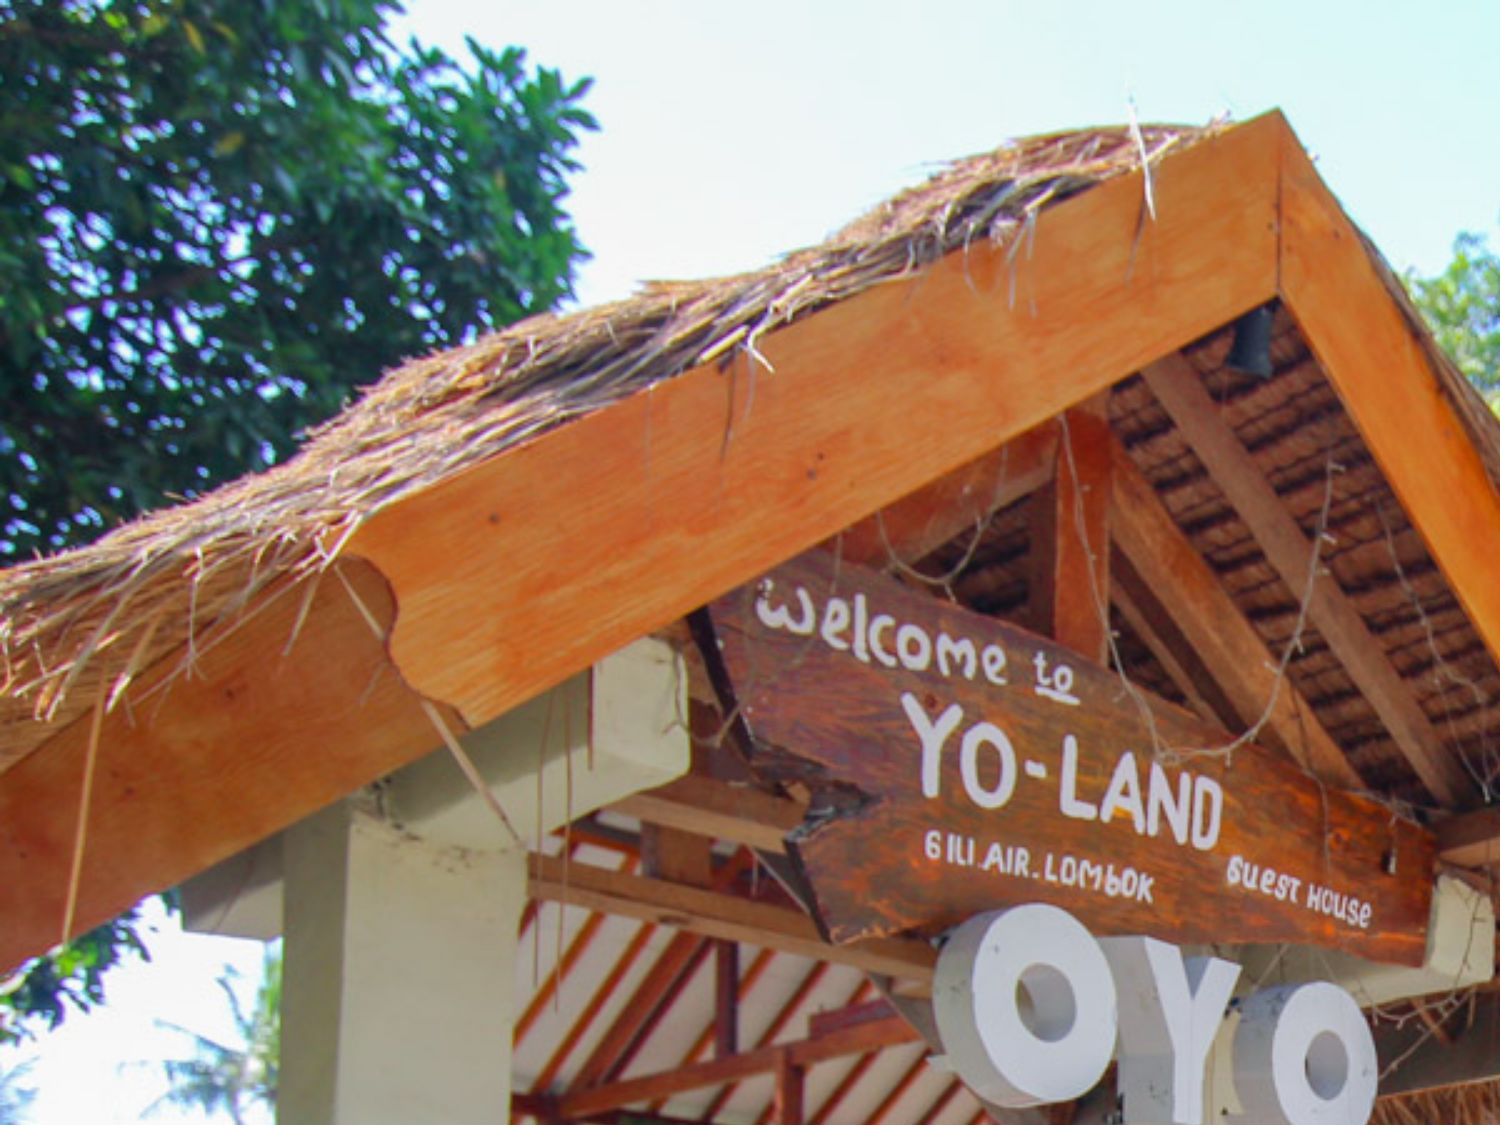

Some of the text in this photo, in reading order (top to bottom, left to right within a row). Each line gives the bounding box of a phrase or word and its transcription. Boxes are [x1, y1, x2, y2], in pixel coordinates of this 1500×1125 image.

[756, 578, 1076, 694] Welcome to
[899, 691, 1223, 851] YO-LAND
